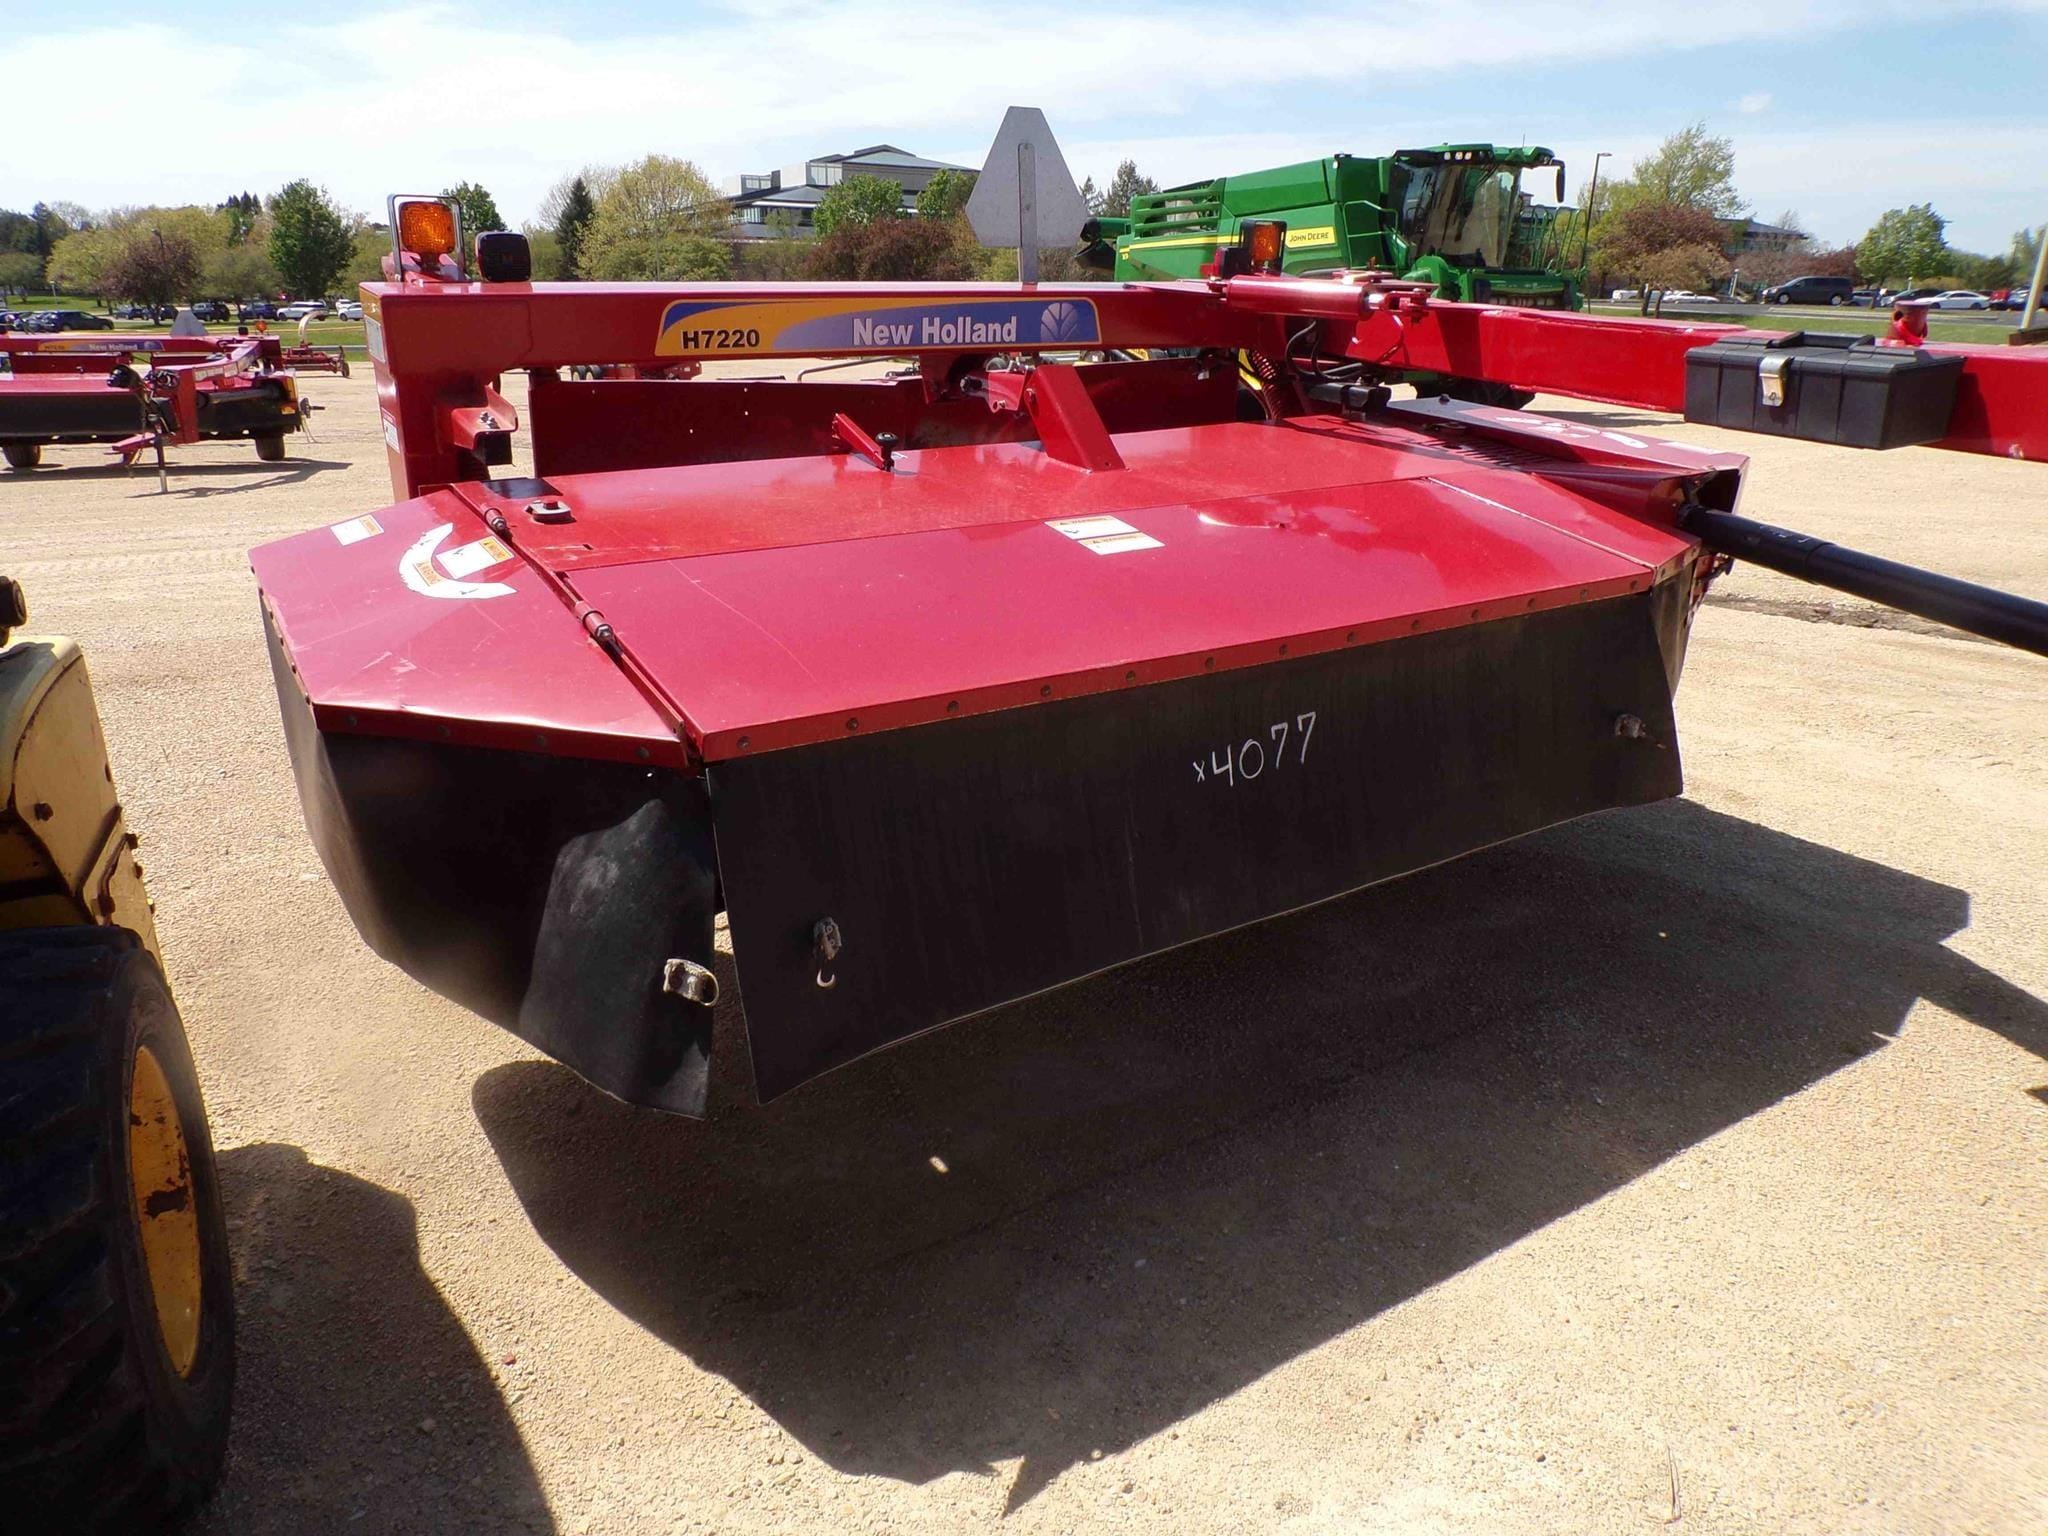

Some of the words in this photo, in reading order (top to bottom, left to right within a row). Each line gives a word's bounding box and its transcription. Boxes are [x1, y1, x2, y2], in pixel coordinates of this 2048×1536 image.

[1289, 234, 1306, 242] JOHN
[1307, 232, 1329, 240] DEERE
[682, 329, 760, 349] H7220
[853, 317, 914, 346] New
[922, 315, 1017, 344] Holland
